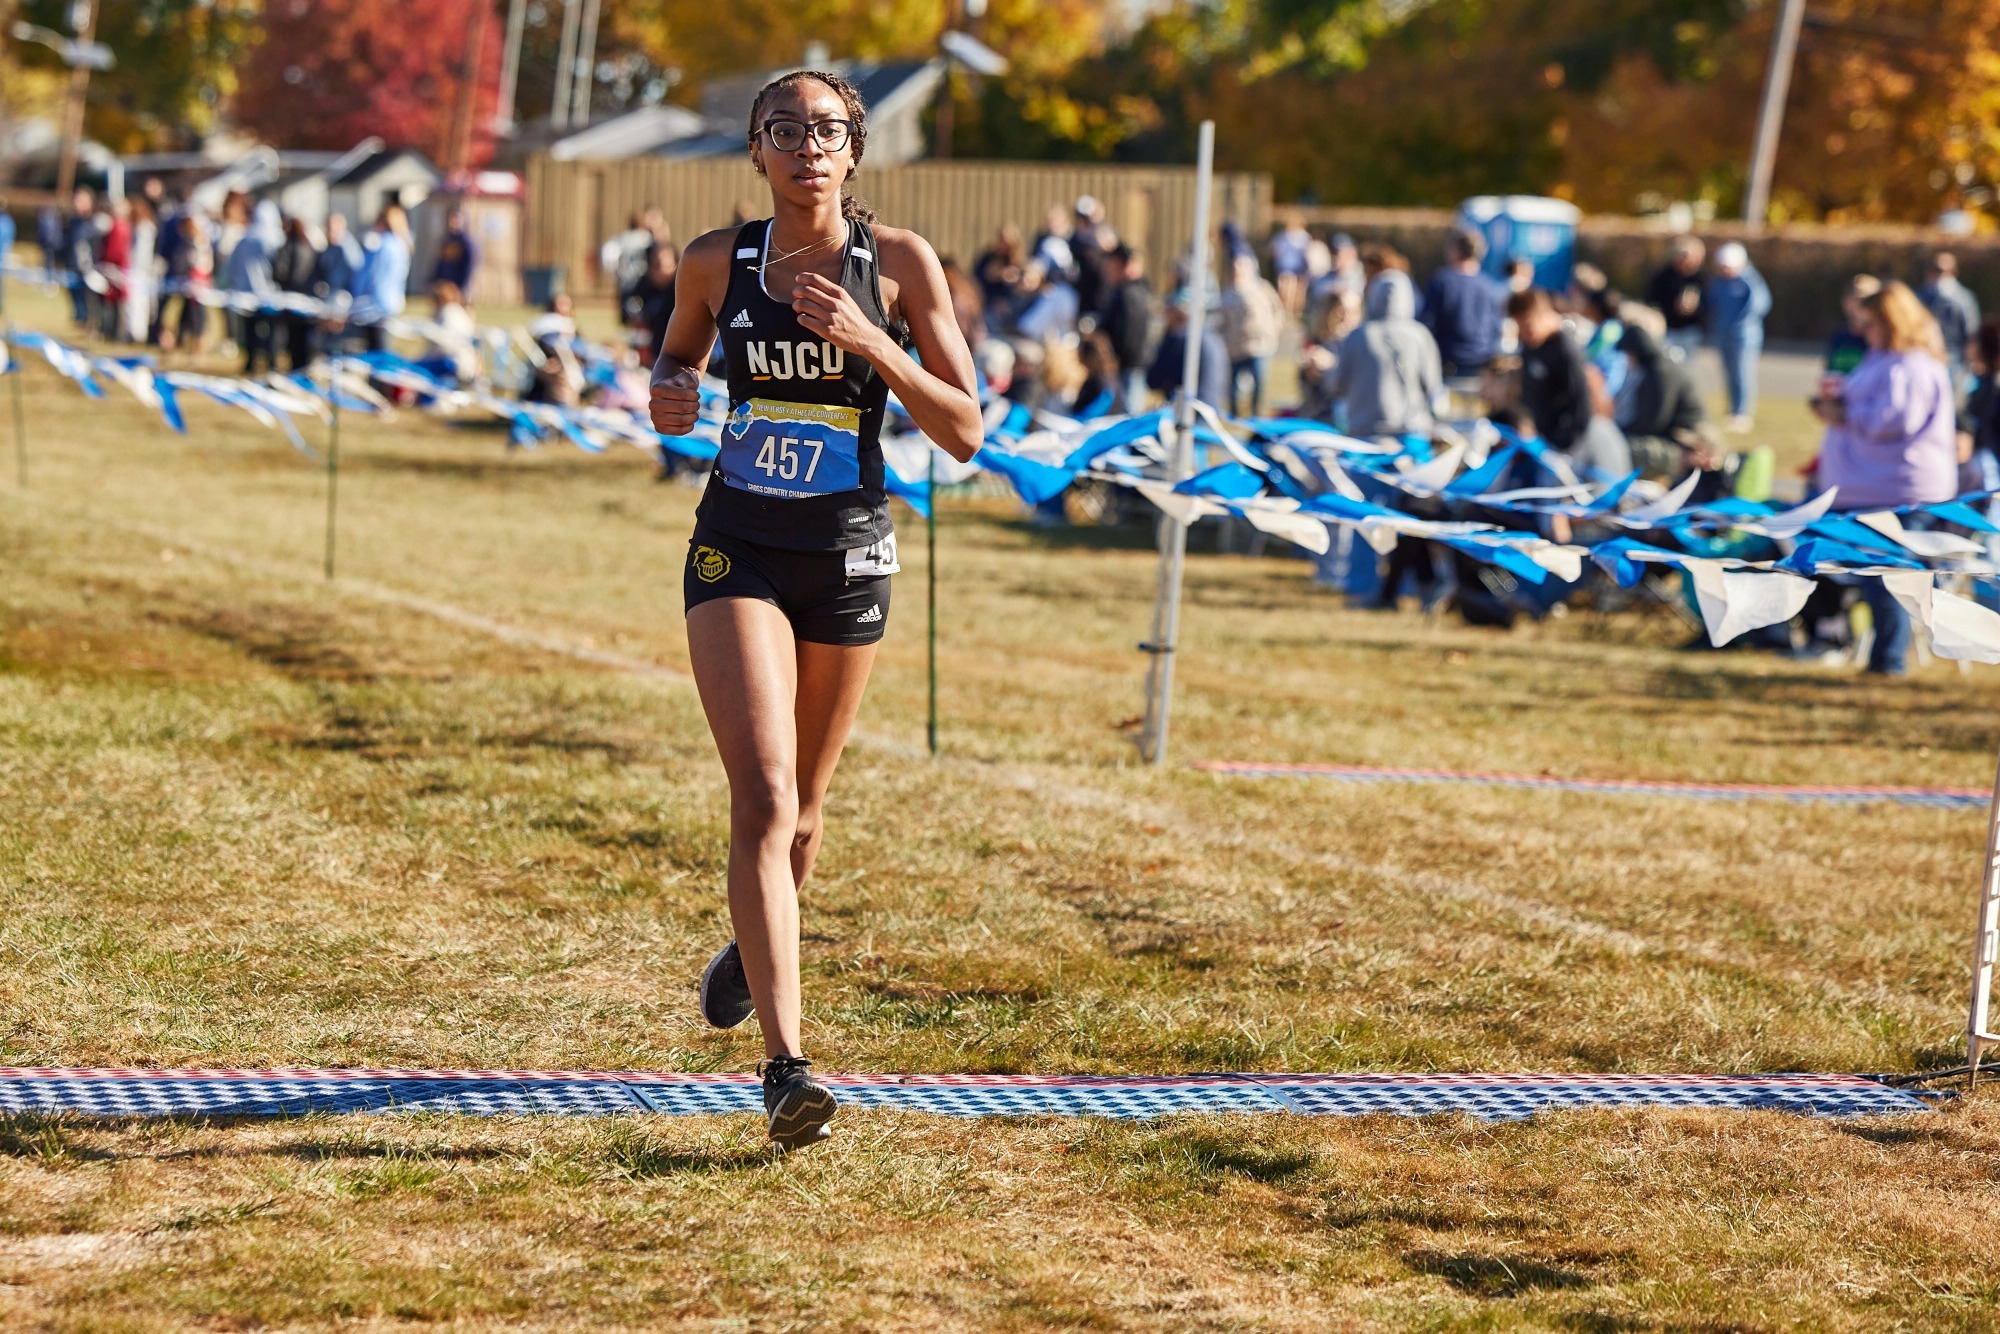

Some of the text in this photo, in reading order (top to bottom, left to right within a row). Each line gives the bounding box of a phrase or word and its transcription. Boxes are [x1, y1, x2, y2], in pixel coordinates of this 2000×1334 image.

[730, 320, 753, 328] adidas
[746, 341, 844, 380] NJCU
[756, 403, 850, 420] NEW JERSEY ATHLETIC CONFERENCE
[754, 435, 824, 483] 457
[747, 482, 763, 493] CROSS
[763, 486, 789, 497] COUNTRY
